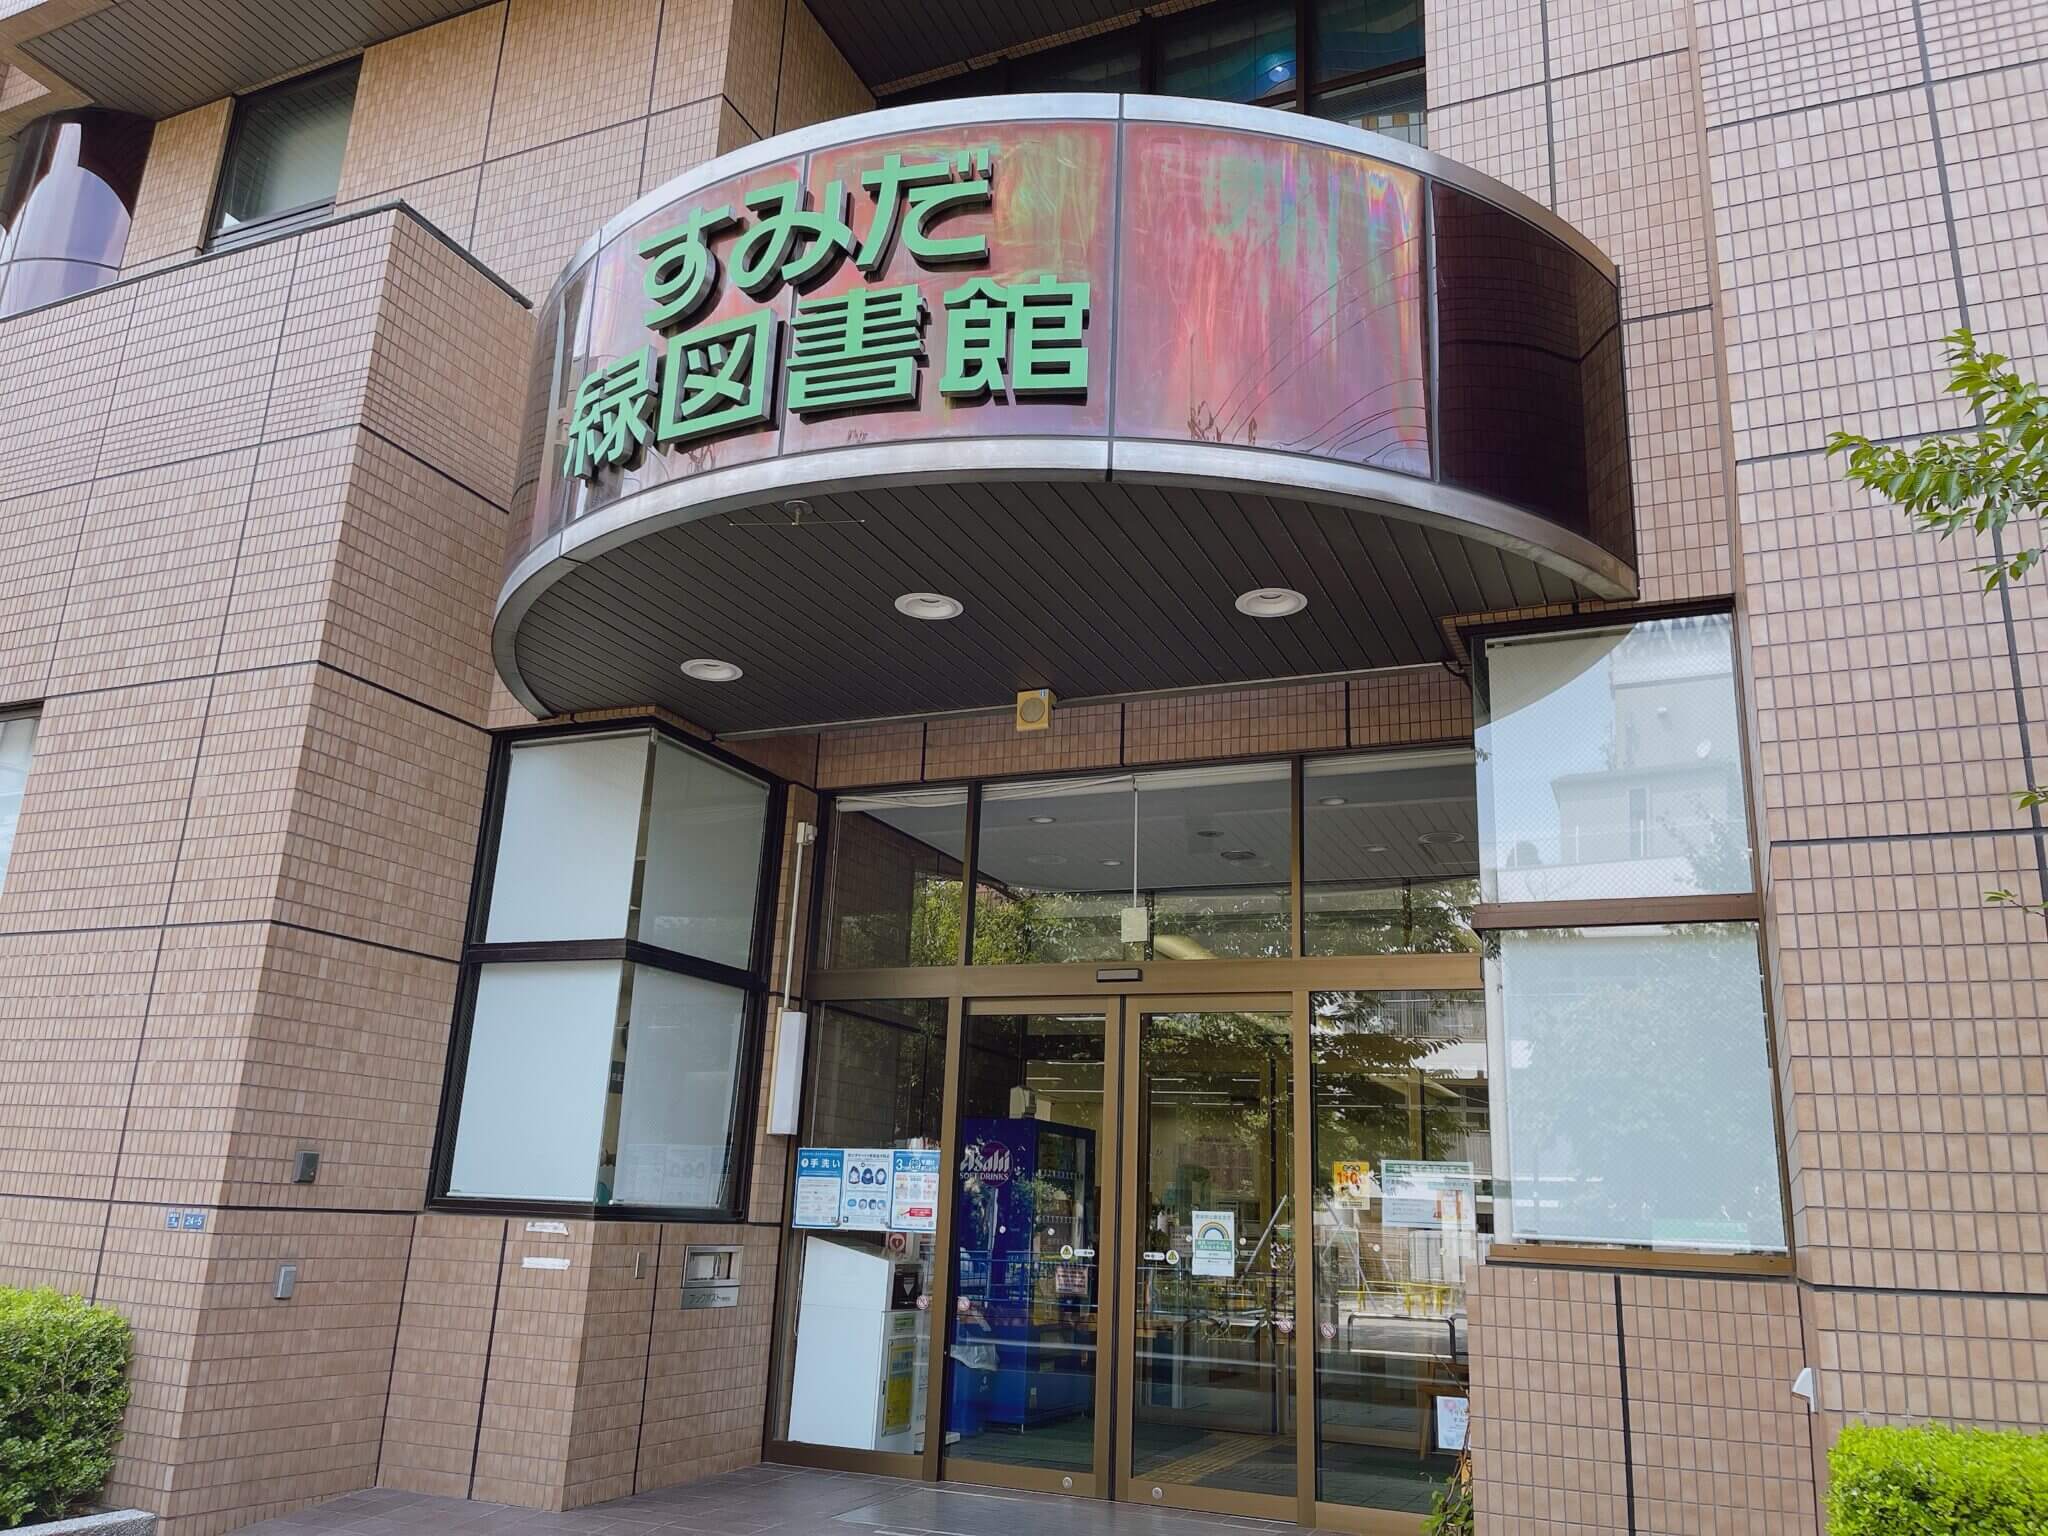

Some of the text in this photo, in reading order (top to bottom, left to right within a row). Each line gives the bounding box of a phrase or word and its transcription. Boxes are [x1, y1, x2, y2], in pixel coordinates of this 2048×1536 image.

[639, 147, 993, 330] すみだ
[564, 274, 1091, 480] 緑図書館
[960, 1147, 1010, 1172] Asahi
[960, 1172, 1009, 1181] SOFT DRINKS
